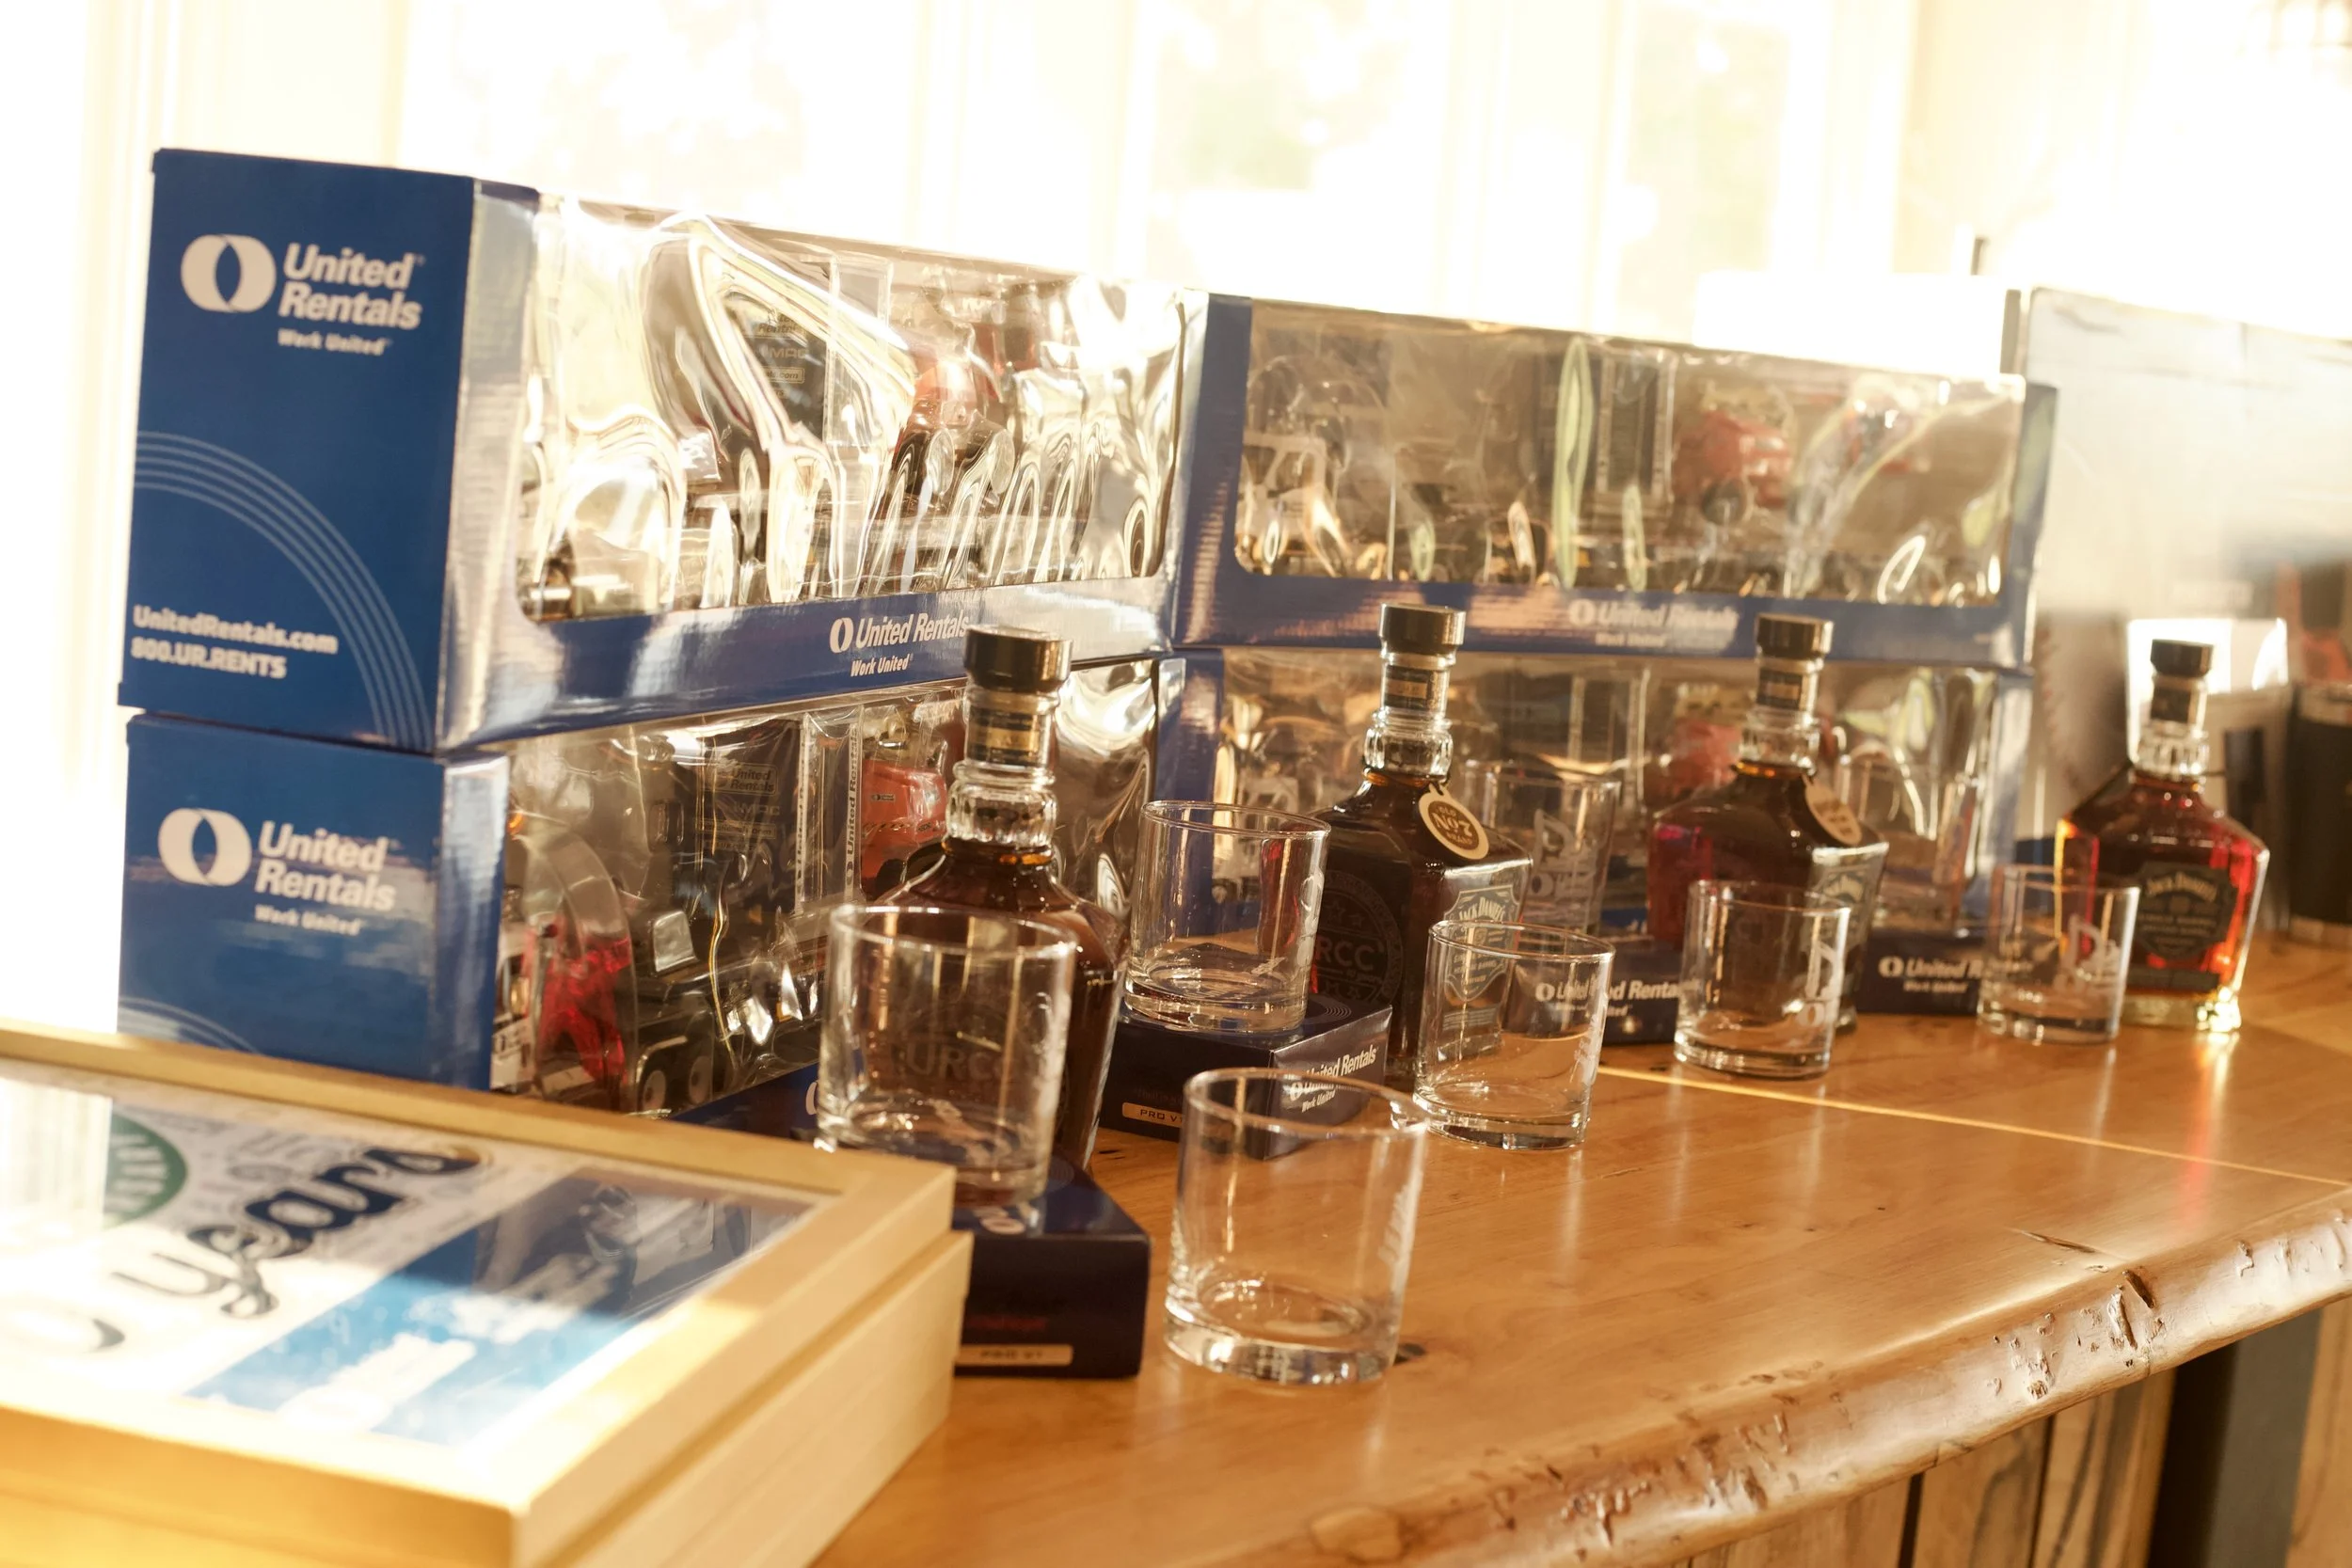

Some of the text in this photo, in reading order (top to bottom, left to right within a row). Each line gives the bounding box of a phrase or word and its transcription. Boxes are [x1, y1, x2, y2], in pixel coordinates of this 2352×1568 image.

[283, 242, 416, 290] United
[278, 279, 423, 330] Rentals
[278, 327, 387, 356] Work United
[1599, 600, 1671, 627] United
[133, 604, 339, 656] UnitedRentals.com
[855, 610, 970, 649] United Rentals
[131, 636, 287, 680] 800.UR.RENTS
[850, 653, 911, 677] Work United
[730, 779, 775, 792] Rentals
[734, 768, 771, 781] United
[847, 727, 859, 855] United Rentals
[259, 819, 389, 873] United
[254, 857, 397, 911] Rentals
[301, 911, 363, 936] United
[1316, 936, 1376, 973] RCC
[1905, 957, 1969, 979] United
[1629, 978, 1693, 1000] Renta
[1341, 1044, 1376, 1077] Rentals
[1139, 1109, 1166, 1121] PRO
[1302, 1088, 1336, 1114] Work United
